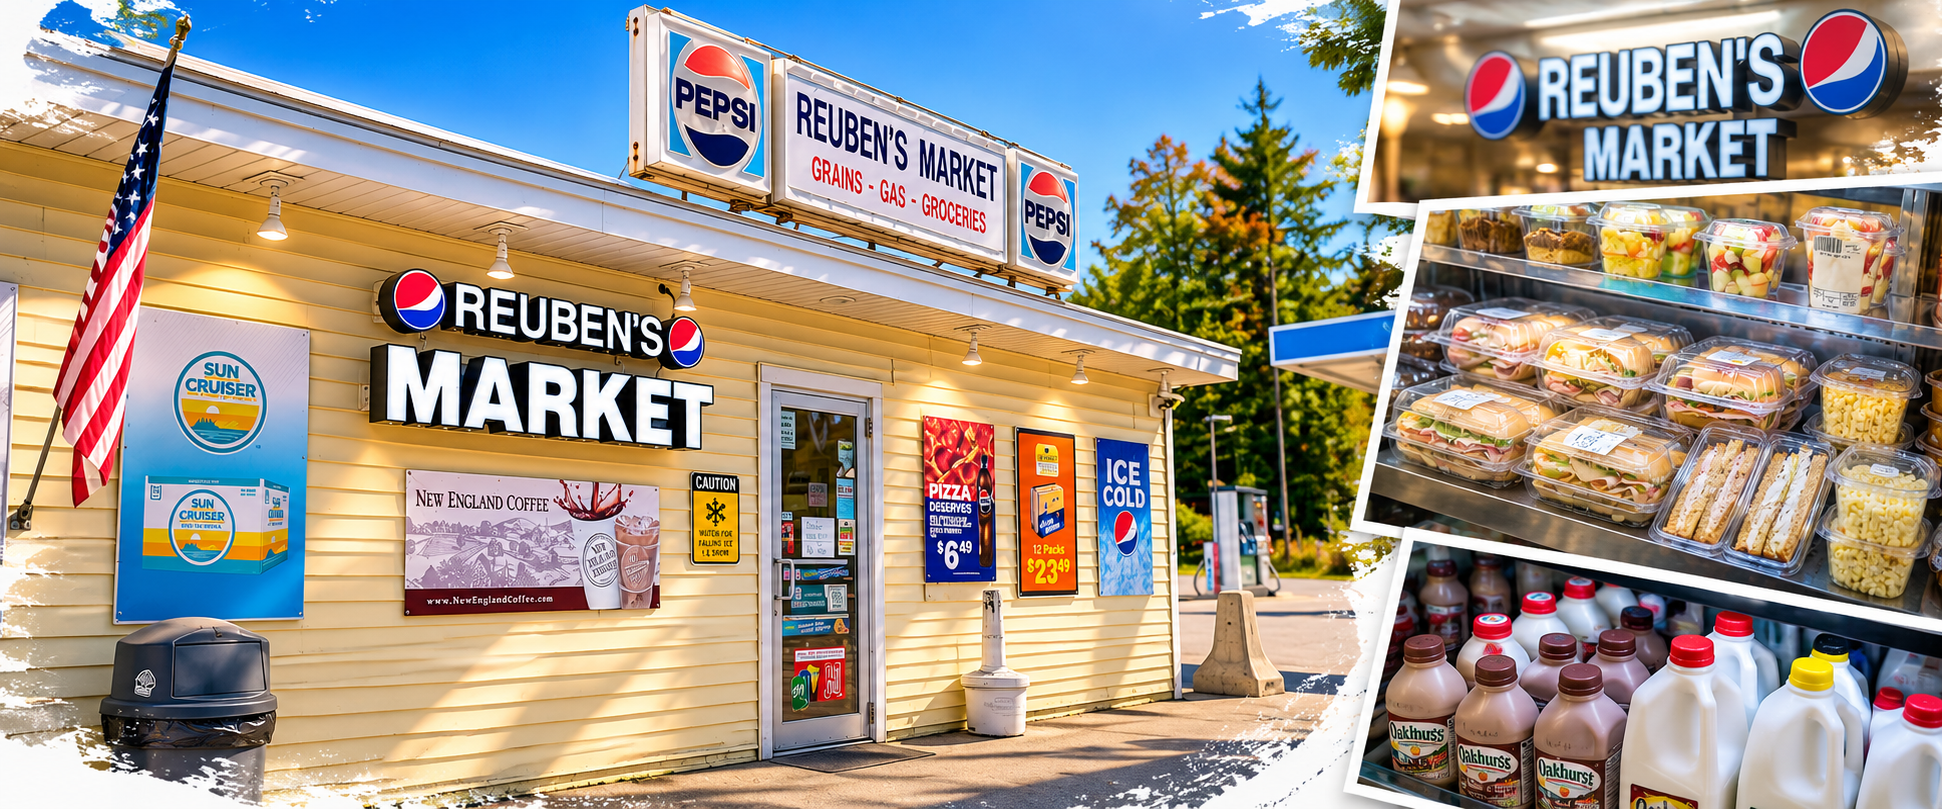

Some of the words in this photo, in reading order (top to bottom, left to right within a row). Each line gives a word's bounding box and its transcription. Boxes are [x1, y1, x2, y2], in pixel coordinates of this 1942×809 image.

[1538, 32, 1785, 121] REUBEN'S
[675, 77, 756, 132] PEPSI
[796, 91, 908, 172] REUBEN'S
[919, 138, 998, 202] MARKET
[1583, 118, 1778, 182] MARKET
[811, 155, 863, 195] GRAINS
[879, 179, 906, 209] GAS
[921, 194, 987, 235] GROCERIES
[1024, 199, 1070, 237] PEPSI
[455, 282, 663, 357] REUBEN'S
[204, 362, 239, 378] SUN
[185, 378, 257, 398] CRUISER
[386, 343, 714, 450] MARKET
[695, 475, 736, 491] CAUTION
[1106, 458, 1141, 487] ICE
[191, 498, 214, 509] SUN
[929, 483, 971, 501] PIZZA
[1103, 485, 1145, 508] COLD
[179, 510, 225, 521] CRUISER
[1033, 544, 1042, 554] 12
[1538, 758, 1594, 786] Oakhurst
